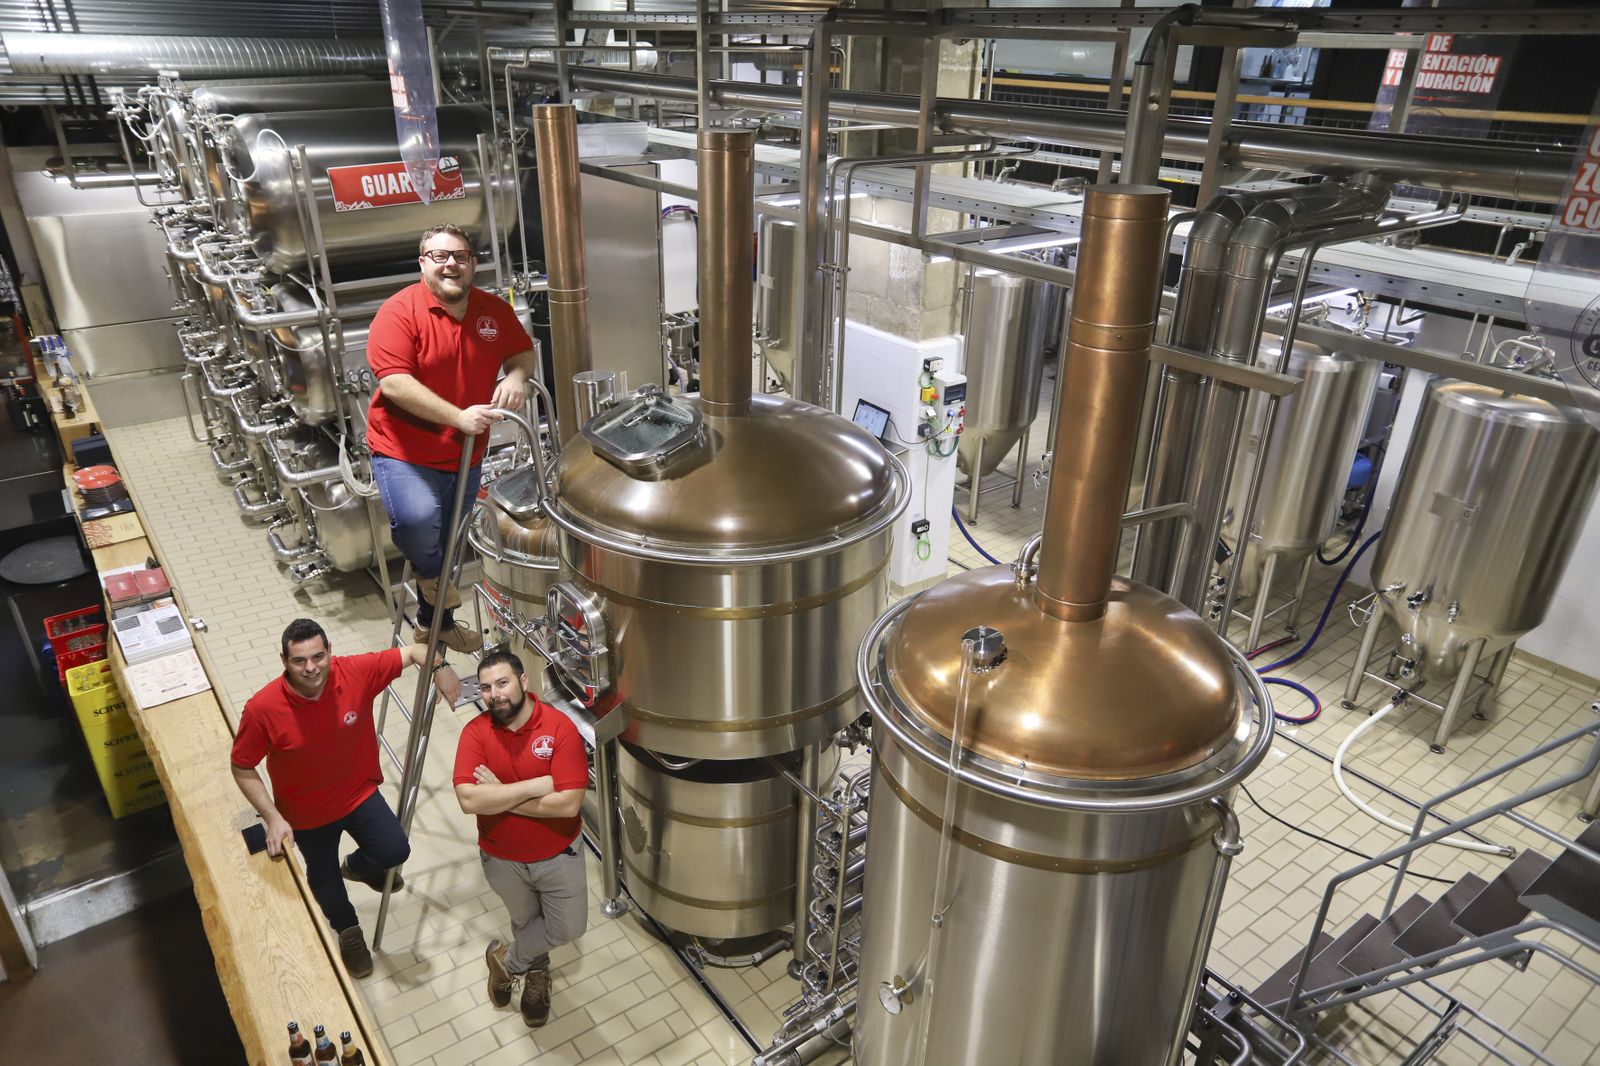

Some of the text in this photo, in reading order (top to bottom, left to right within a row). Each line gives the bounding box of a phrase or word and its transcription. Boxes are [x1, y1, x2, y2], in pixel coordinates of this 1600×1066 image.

[1430, 35, 1451, 51] DE
[1389, 52, 1499, 74] FEENTACIÓN
[361, 172, 436, 197] GUAR
